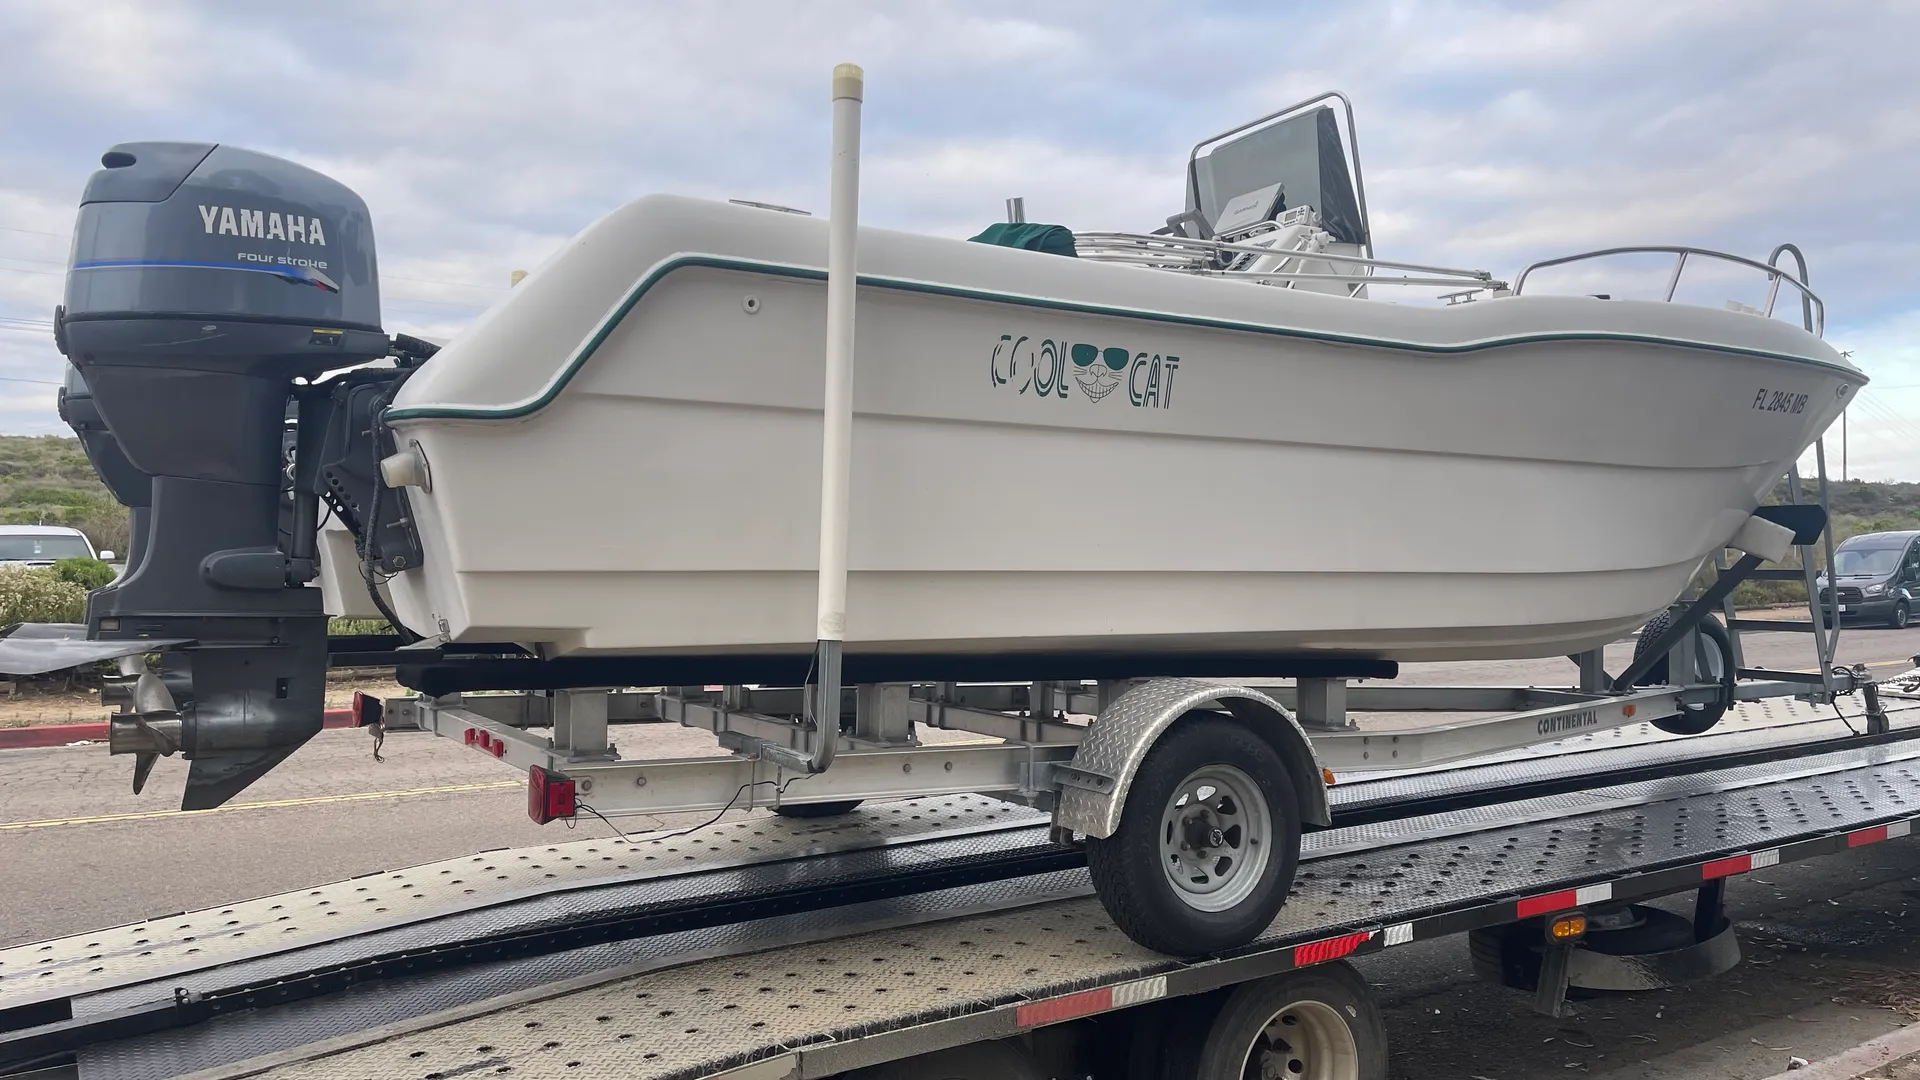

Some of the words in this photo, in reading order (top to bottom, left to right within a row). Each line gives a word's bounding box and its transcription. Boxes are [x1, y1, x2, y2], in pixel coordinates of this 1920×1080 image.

[198, 205, 326, 246] YAMAHA
[1128, 352, 1180, 409] CAT
[1752, 388, 1768, 410] FL
[1537, 710, 1598, 735] CONTINENTAL
